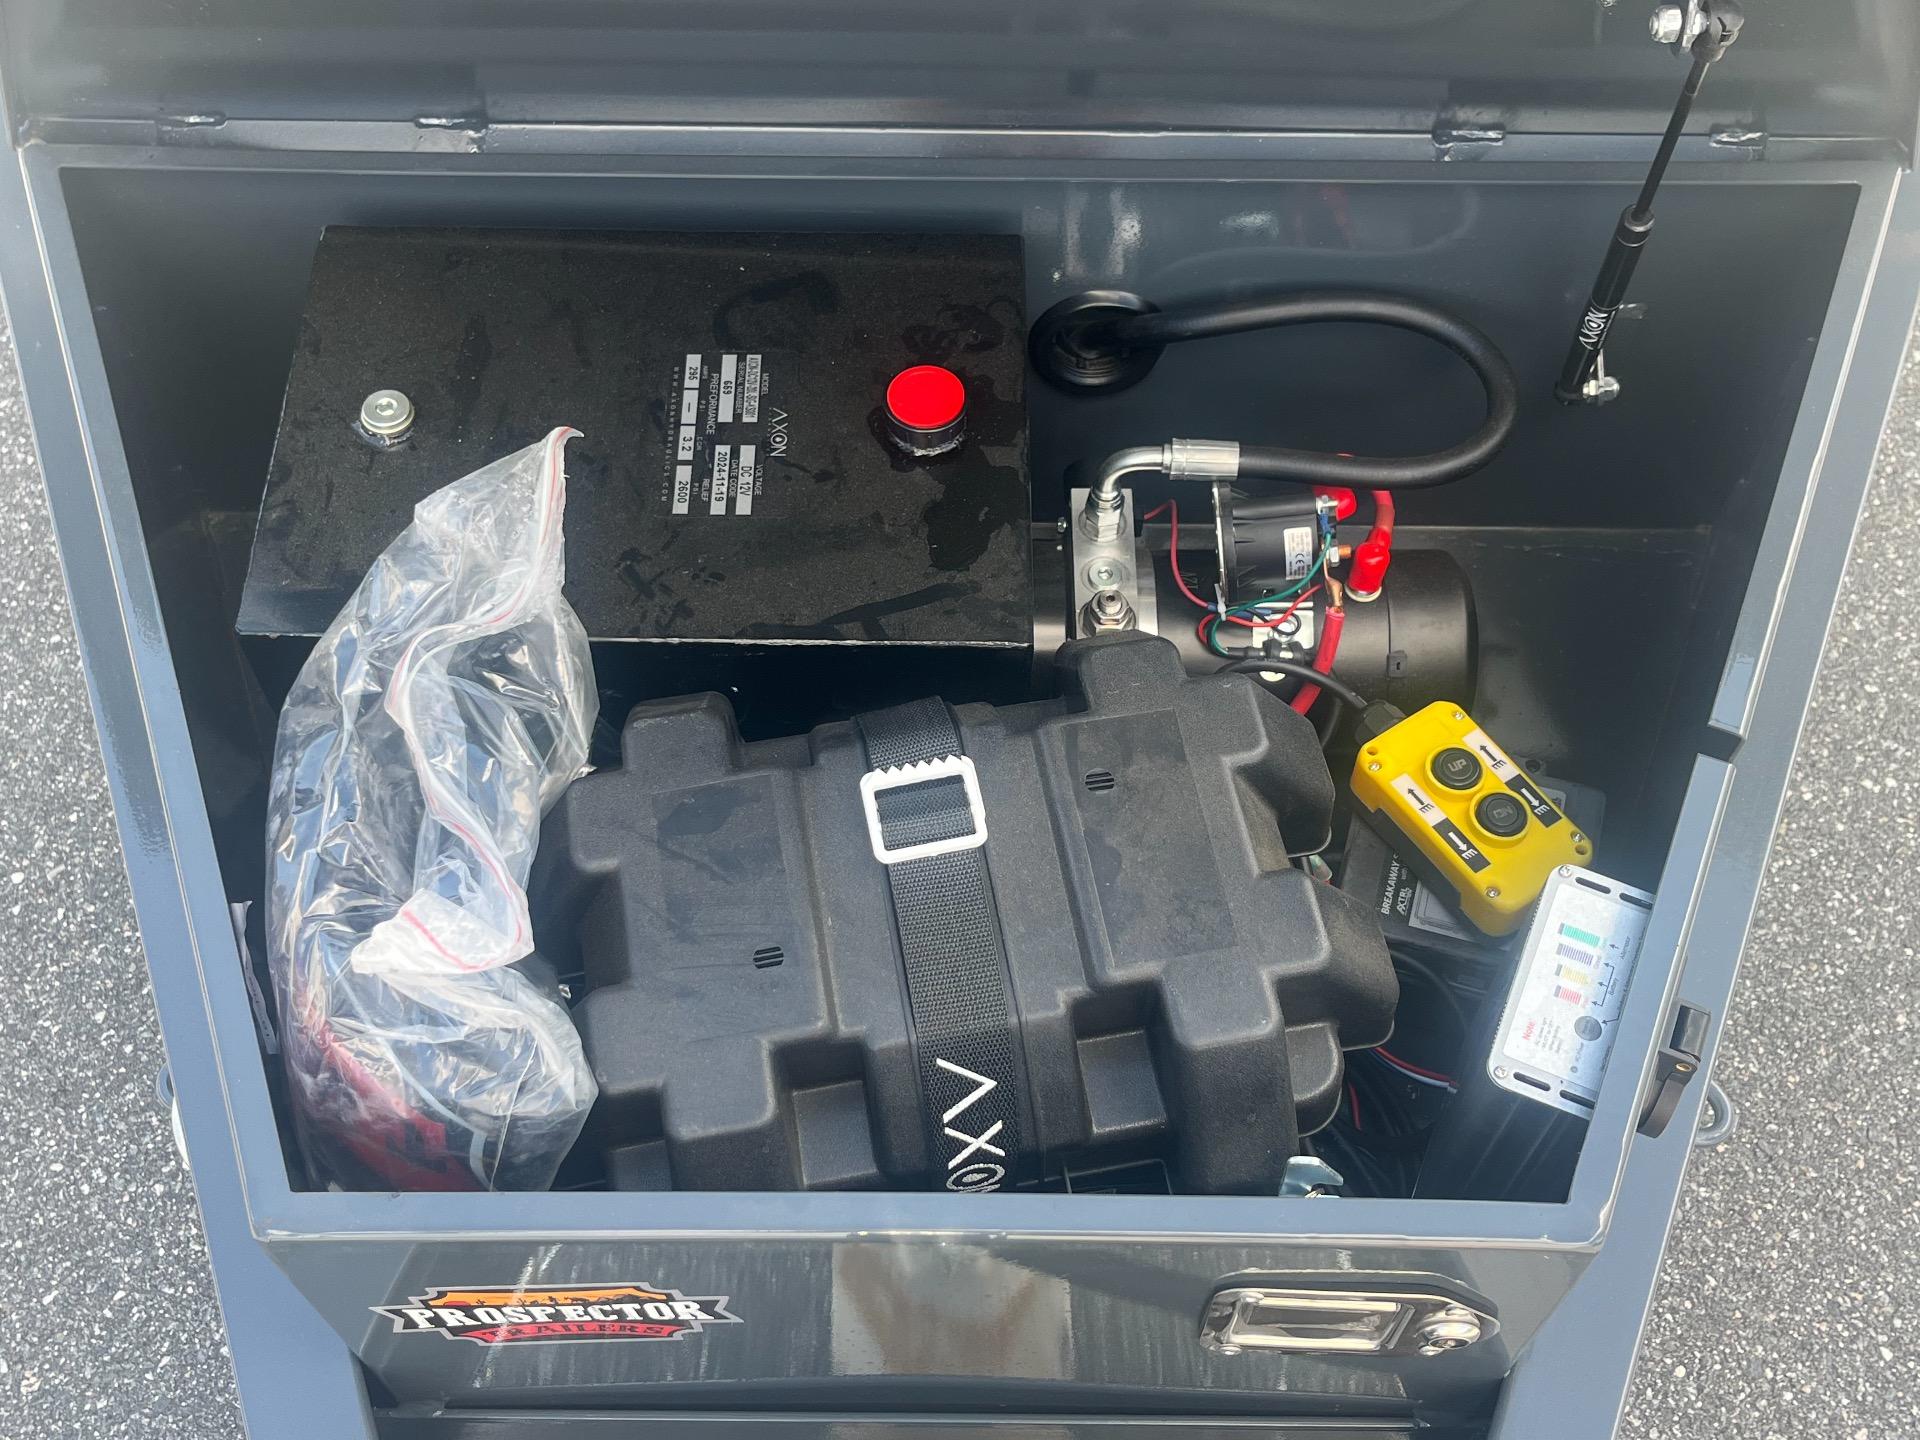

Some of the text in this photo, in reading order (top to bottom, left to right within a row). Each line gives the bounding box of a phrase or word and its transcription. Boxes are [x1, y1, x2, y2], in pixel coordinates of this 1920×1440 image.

[688, 366, 699, 381] 295
[761, 373, 769, 396] MODEL
[706, 373, 719, 435] PREFORMANCE
[681, 436, 693, 452] 3.2
[770, 407, 789, 458] AXON
[701, 478, 710, 502] RELIEF
[714, 451, 728, 502] 2024-11-19
[728, 459, 738, 498] DATE CODE
[739, 466, 752, 496] DC 12V
[755, 464, 763, 496] VOLTAGE
[677, 480, 689, 504] 2600
[1448, 758, 1467, 772] UP
[1380, 860, 1400, 915] BREAKAWAY
[936, 1058, 1005, 1193] AXO
[401, 1300, 715, 1329] PROSPECTOR
[482, 1322, 665, 1338] TRAILERS
